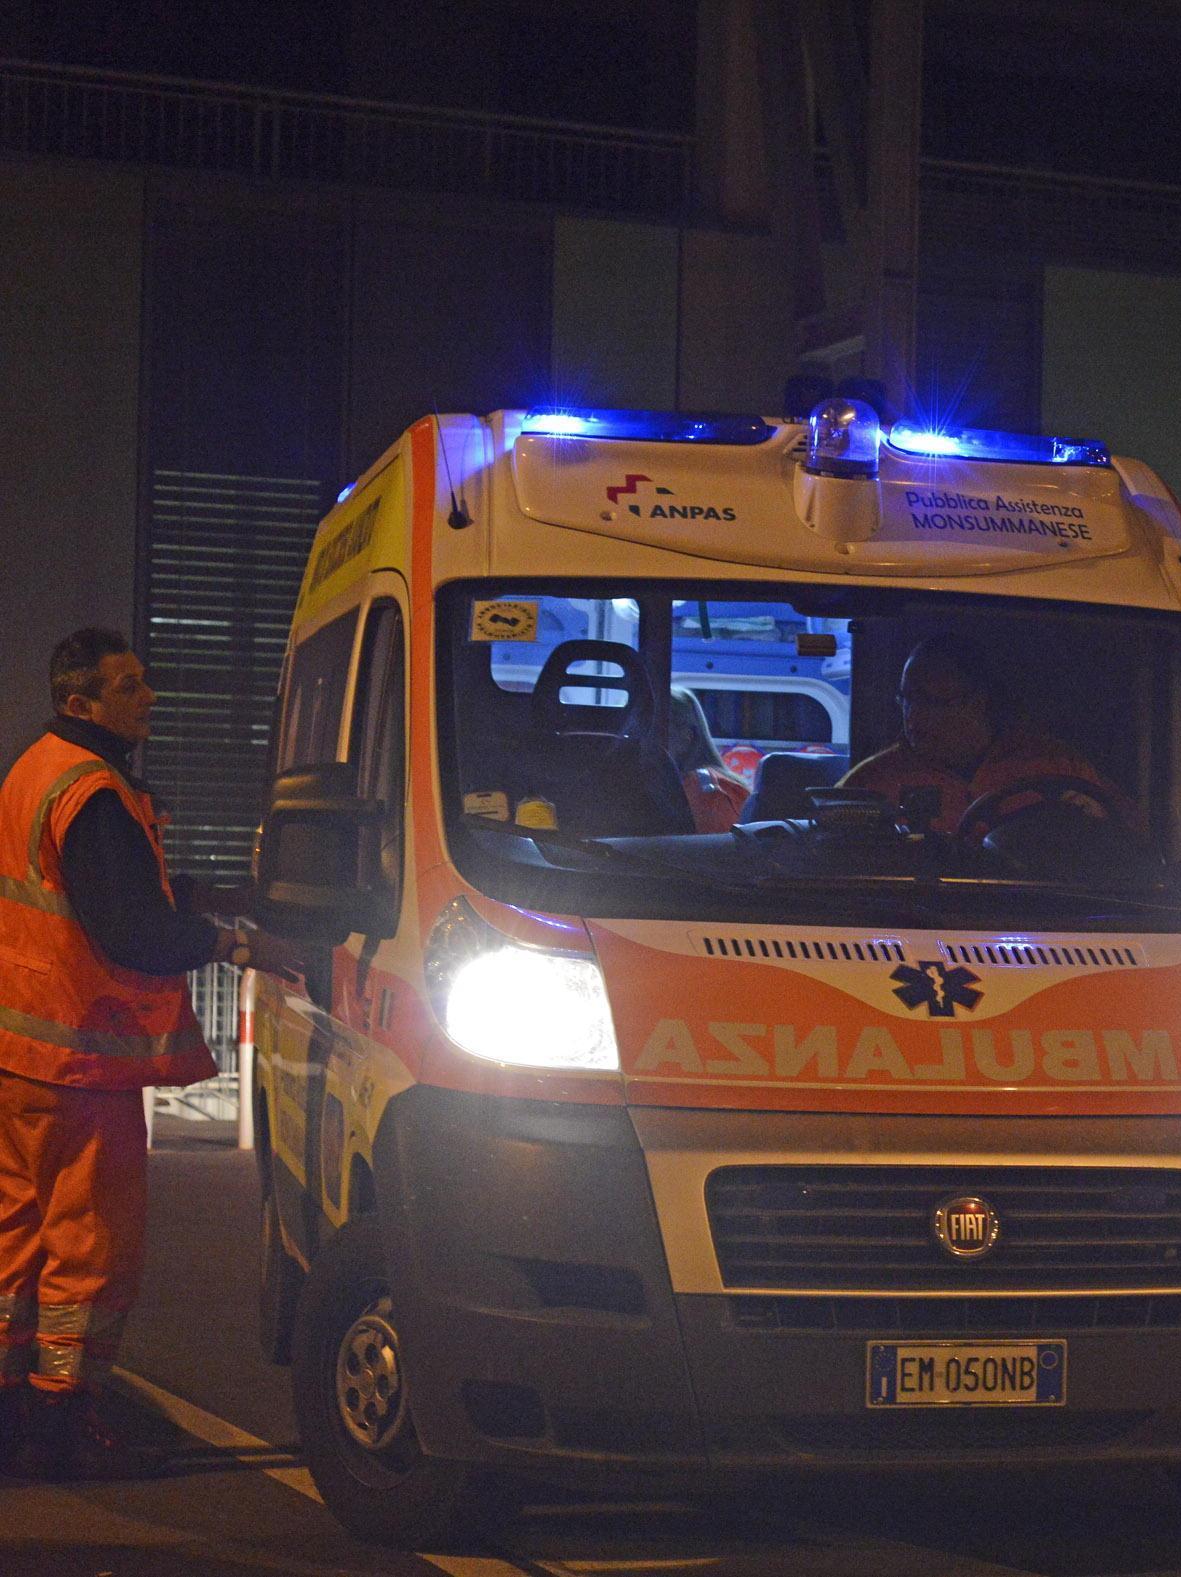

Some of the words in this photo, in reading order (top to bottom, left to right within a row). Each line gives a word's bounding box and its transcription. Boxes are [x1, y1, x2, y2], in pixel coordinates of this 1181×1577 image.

[649, 504, 737, 522] ANPAS
[906, 491, 990, 511] Pubblica
[995, 496, 1085, 519] Assistenza
[912, 513, 1092, 541] MONSUMMANESE
[950, 1213, 986, 1241] FIAT
[900, 1357, 936, 1392] EM
[945, 1356, 1036, 1392] 050NB
